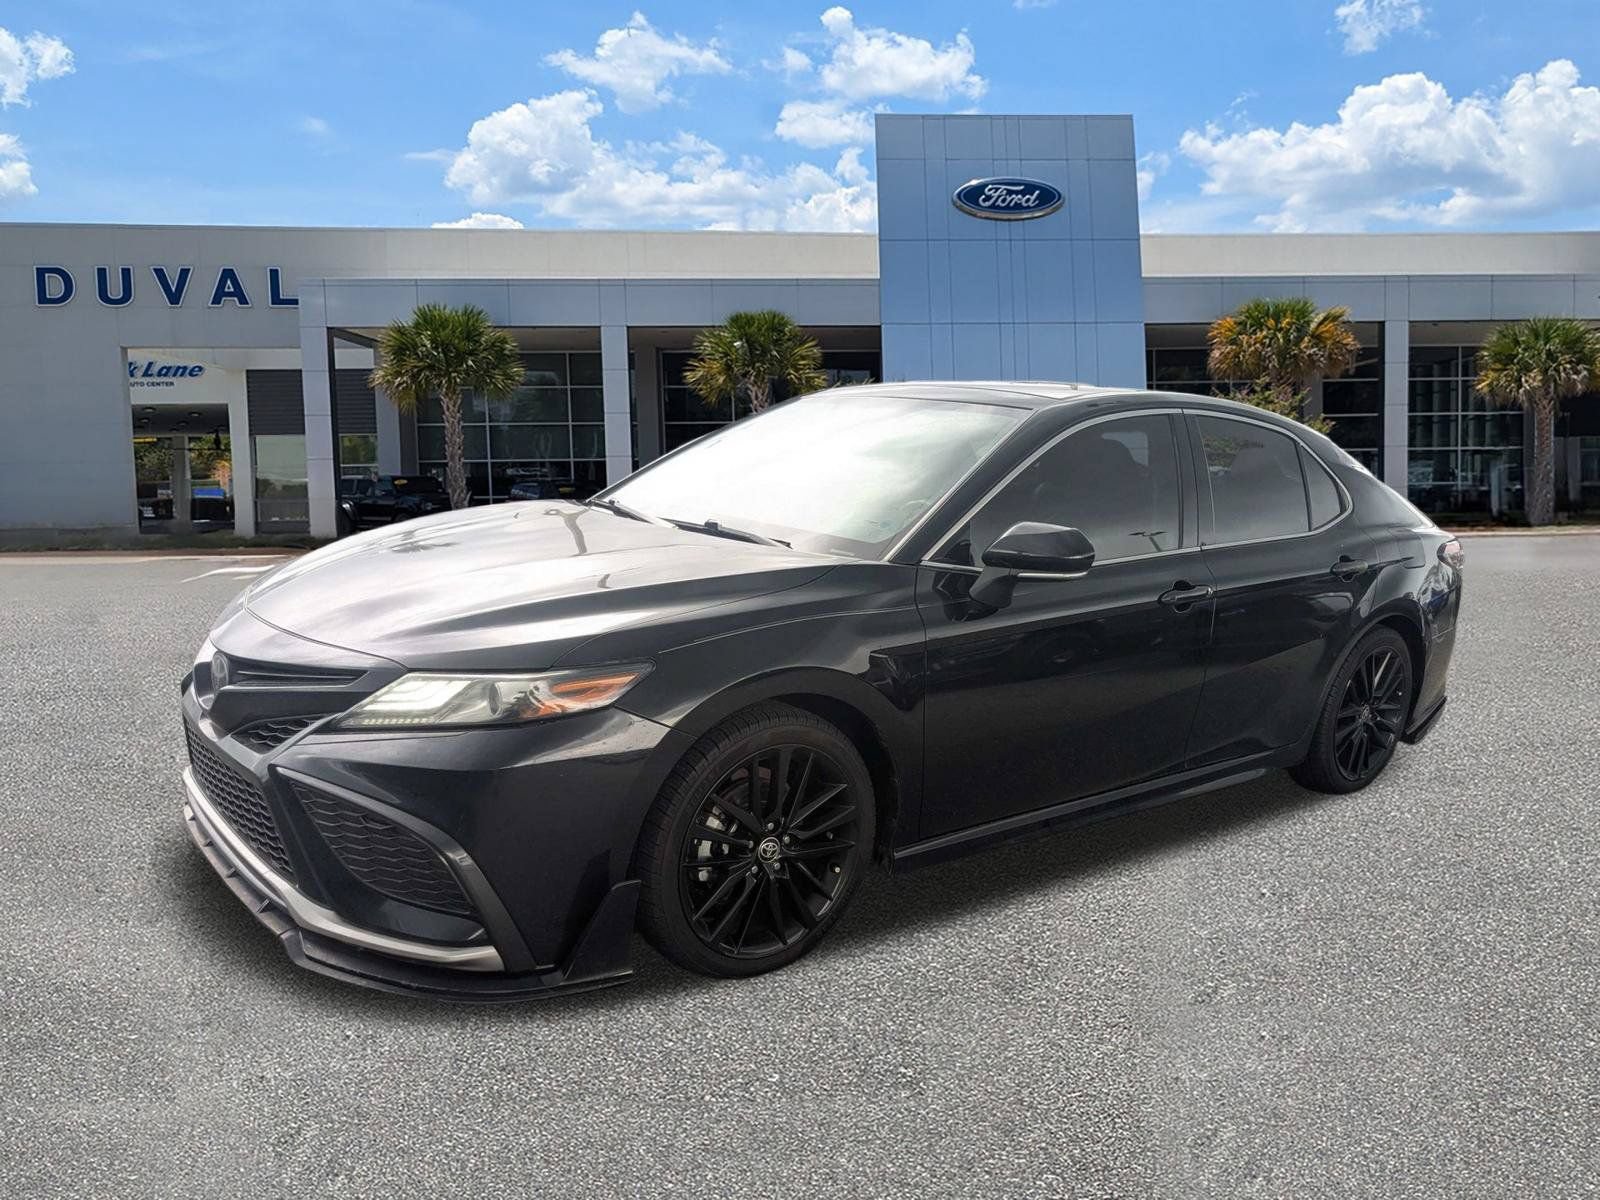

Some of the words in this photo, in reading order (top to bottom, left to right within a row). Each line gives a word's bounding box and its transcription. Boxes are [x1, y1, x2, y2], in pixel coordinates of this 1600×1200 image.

[979, 184, 1040, 207] Ford
[34, 266, 299, 307] DUVAL
[142, 361, 204, 377] Lane
